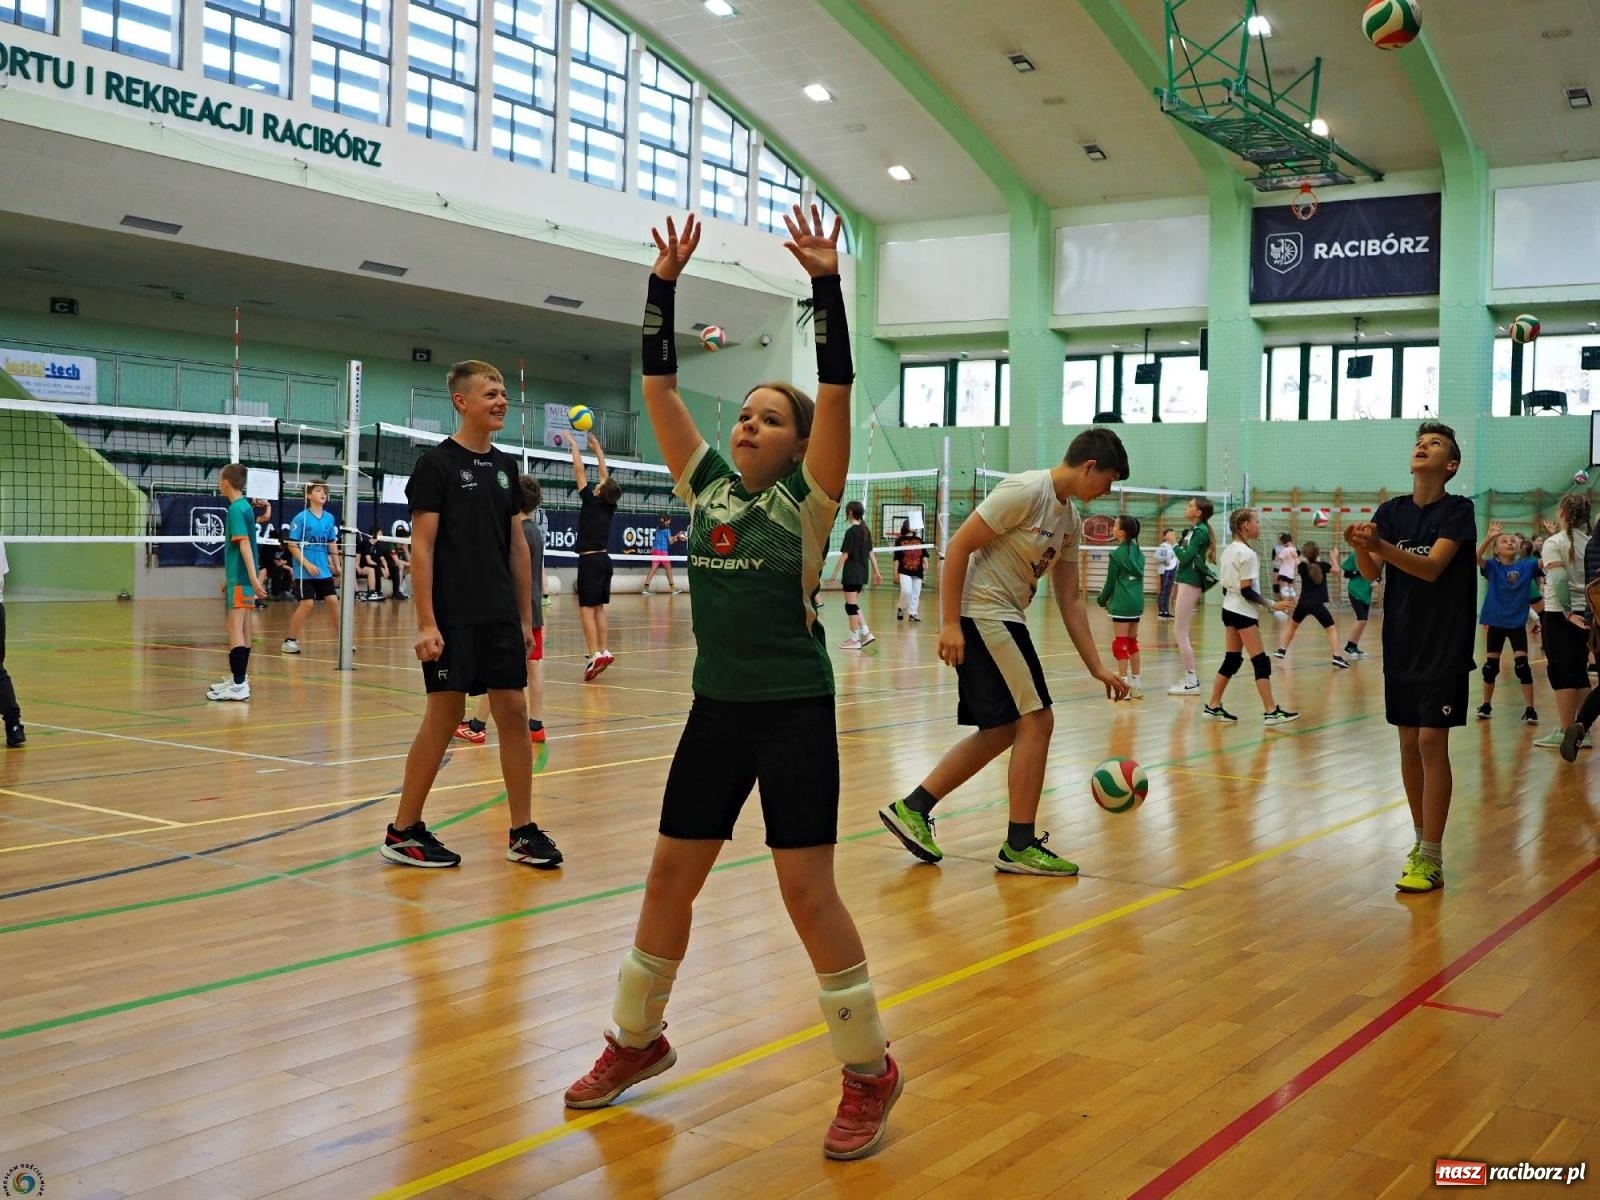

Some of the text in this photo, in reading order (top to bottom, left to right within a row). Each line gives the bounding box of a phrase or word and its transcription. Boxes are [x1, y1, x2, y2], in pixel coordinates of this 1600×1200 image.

[86, 66, 94, 95] I
[105, 71, 254, 135] REKREACJI
[263, 112, 382, 167] RACIBÓRZ
[1314, 232, 1430, 259] RACIBÓRZ
[690, 554, 764, 570] DROBNY
